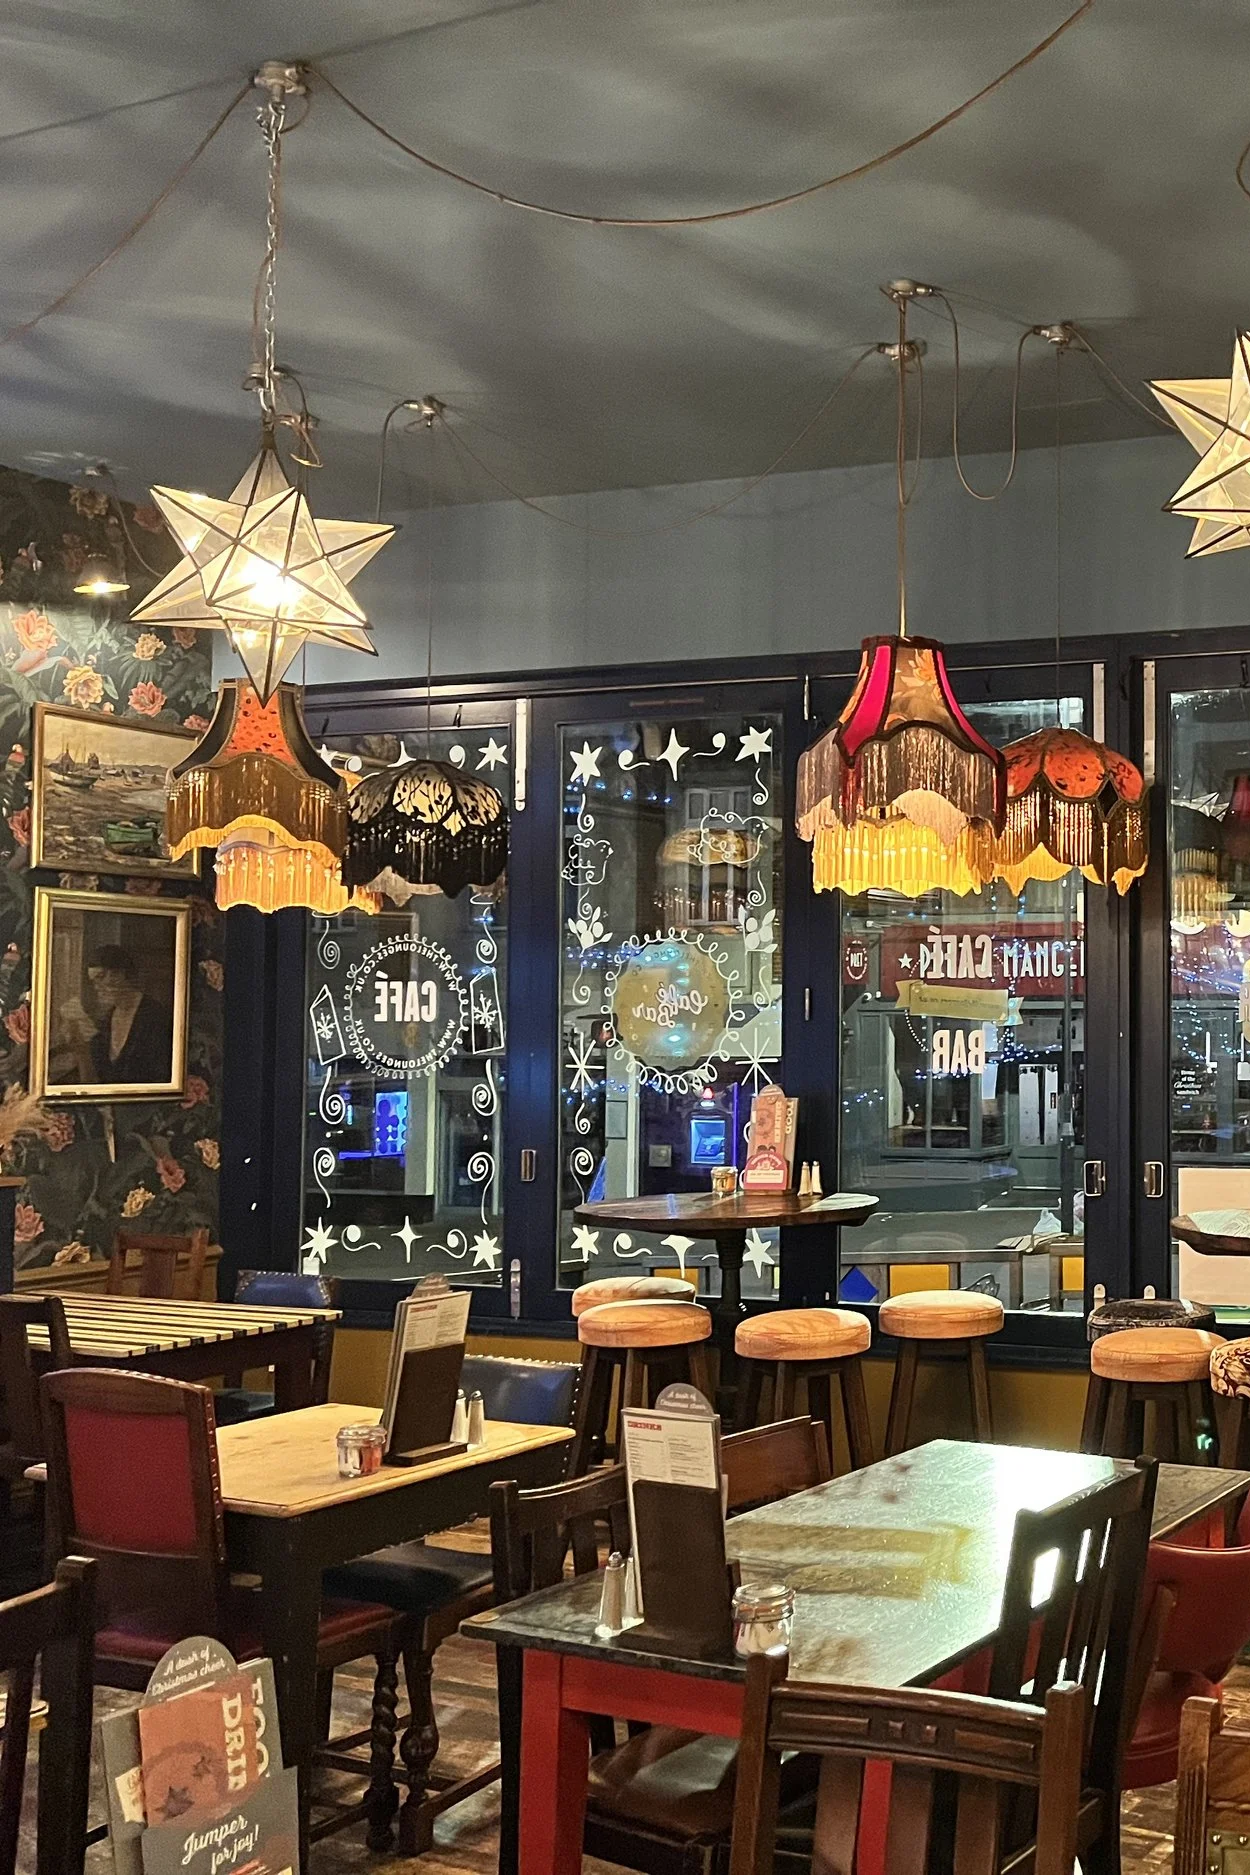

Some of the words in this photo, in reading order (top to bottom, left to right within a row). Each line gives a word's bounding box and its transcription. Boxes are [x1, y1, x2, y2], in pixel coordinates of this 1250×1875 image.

[1003, 940, 1085, 978] MANGE
[151, 1667, 200, 1697] Christmas
[199, 1658, 226, 1676] cheer
[163, 1660, 175, 1677] A
[199, 1645, 212, 1665] of
[251, 1678, 270, 1778] FOO
[181, 1815, 249, 1866] Jumper
[211, 1847, 233, 1875] for
[231, 1824, 260, 1863] joy!
